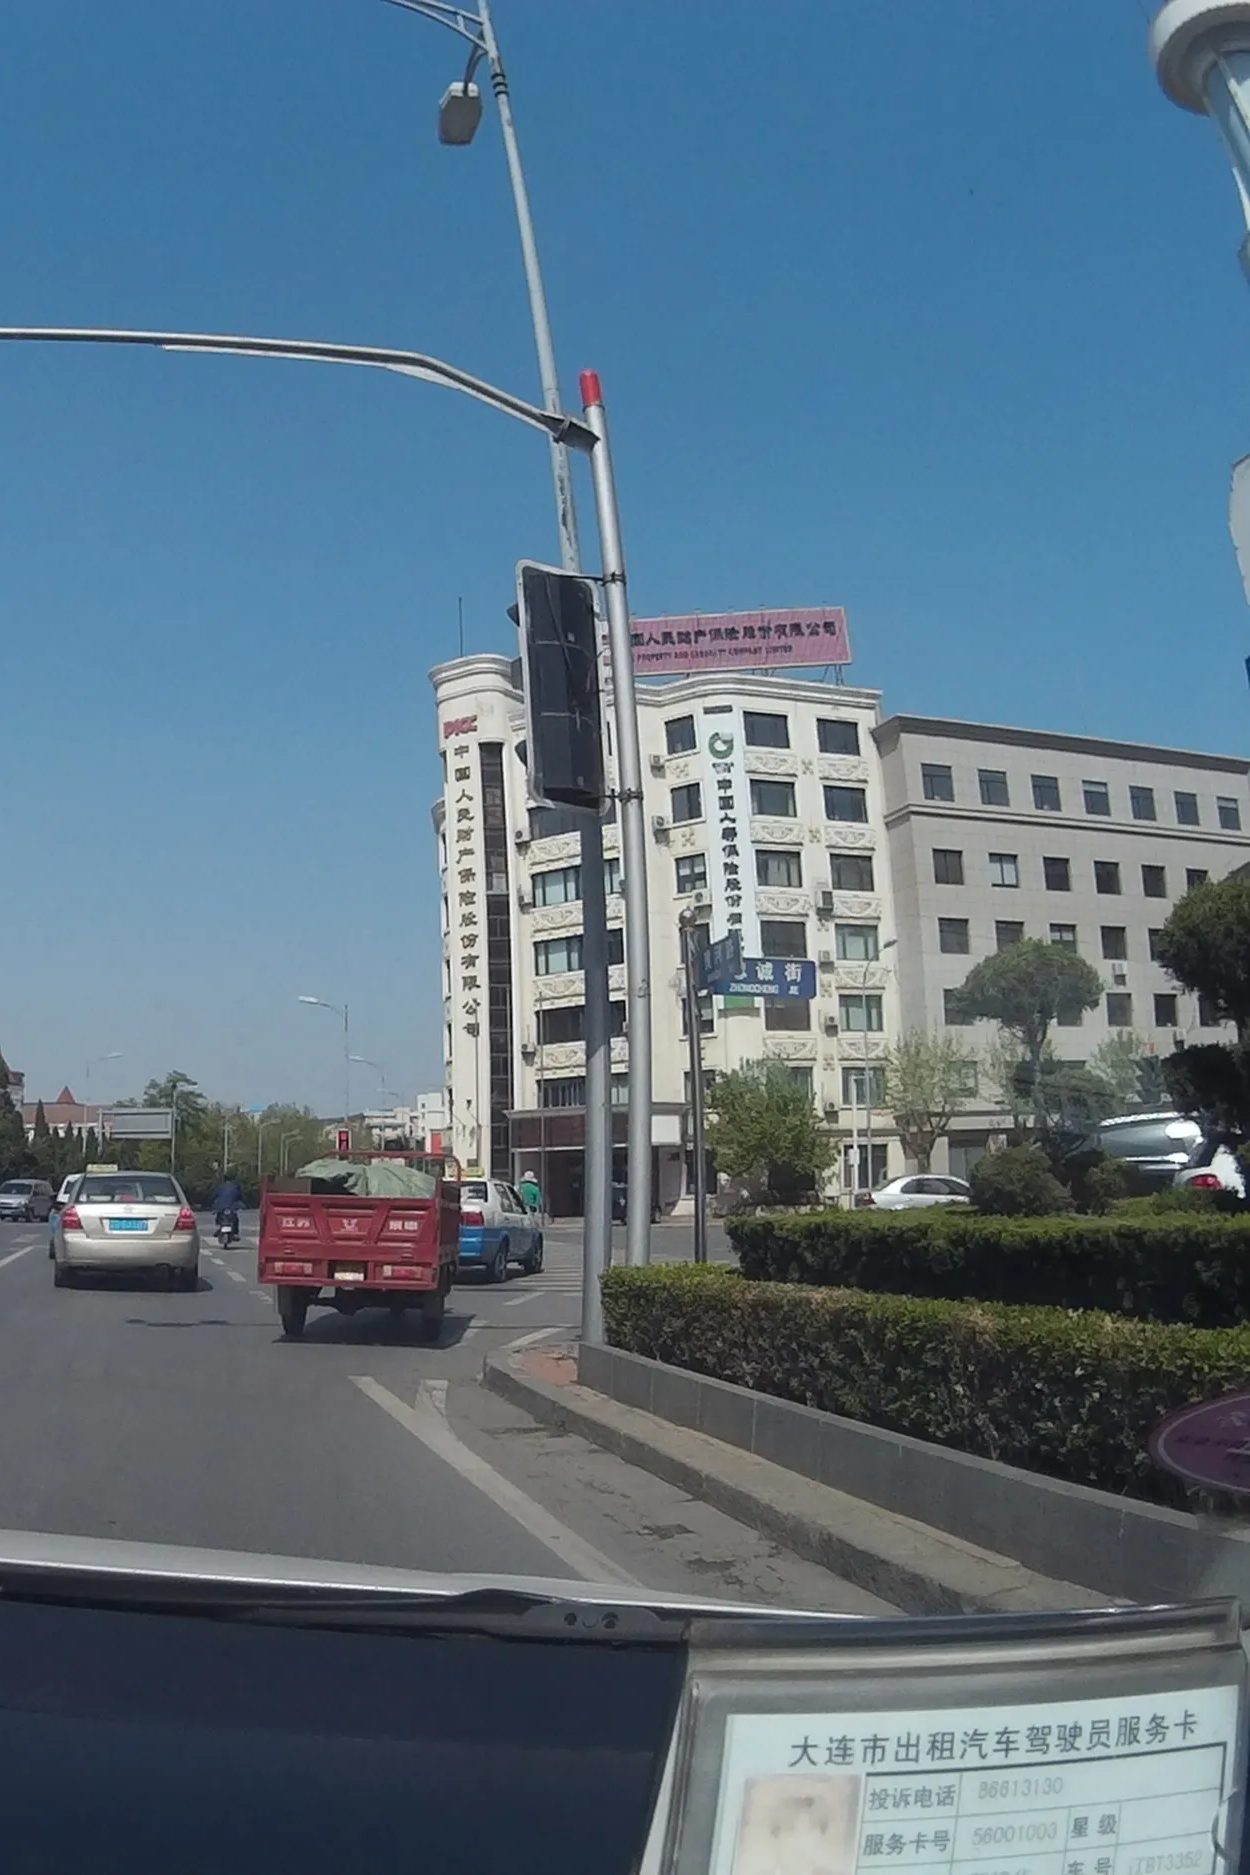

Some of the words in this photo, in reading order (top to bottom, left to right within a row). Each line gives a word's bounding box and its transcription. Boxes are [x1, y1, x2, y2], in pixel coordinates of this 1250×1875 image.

[454, 745, 481, 1038] 中国人民财产保险股份有限公司
[788, 1709, 1198, 1768] 大连市出租汽车驾驶员服务卡
[868, 1783, 956, 1810] 投诉电话
[862, 1829, 951, 1856] 服务卡号
[972, 1822, 1058, 1846] 56001003
